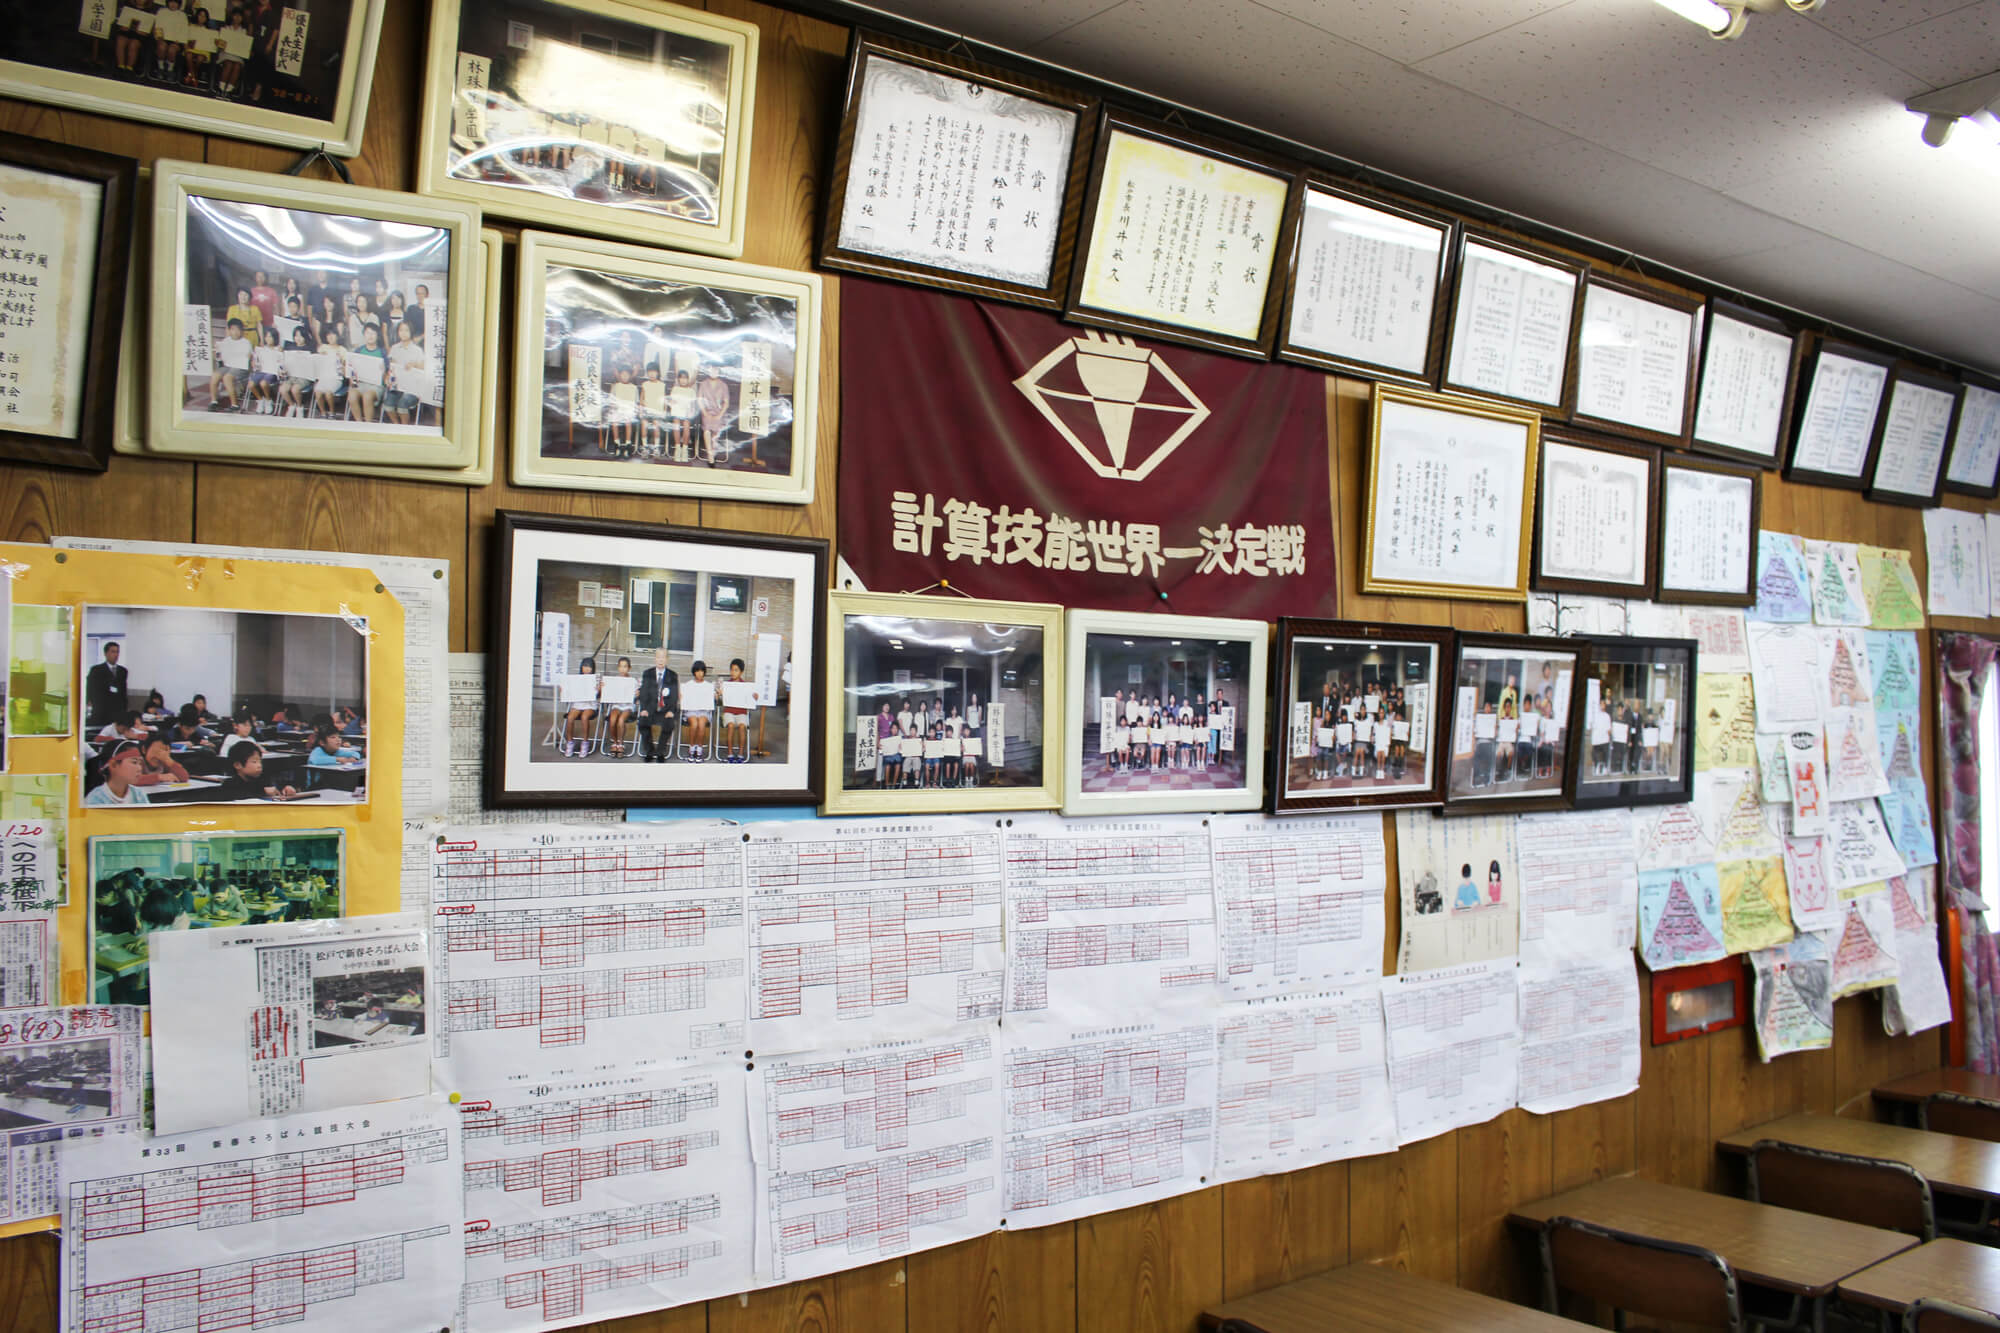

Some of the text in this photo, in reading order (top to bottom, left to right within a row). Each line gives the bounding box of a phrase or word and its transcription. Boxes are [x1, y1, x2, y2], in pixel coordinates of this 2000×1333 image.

[1024, 170, 1046, 229] 賞状
[1243, 232, 1264, 284] 賞状
[891, 491, 1306, 578] 計算技能世界一決定戦
[316, 942, 420, 962] 松戸で新春そろばん大会
[142, 1119, 371, 1158] 第33回 新春そろばん競技大会
